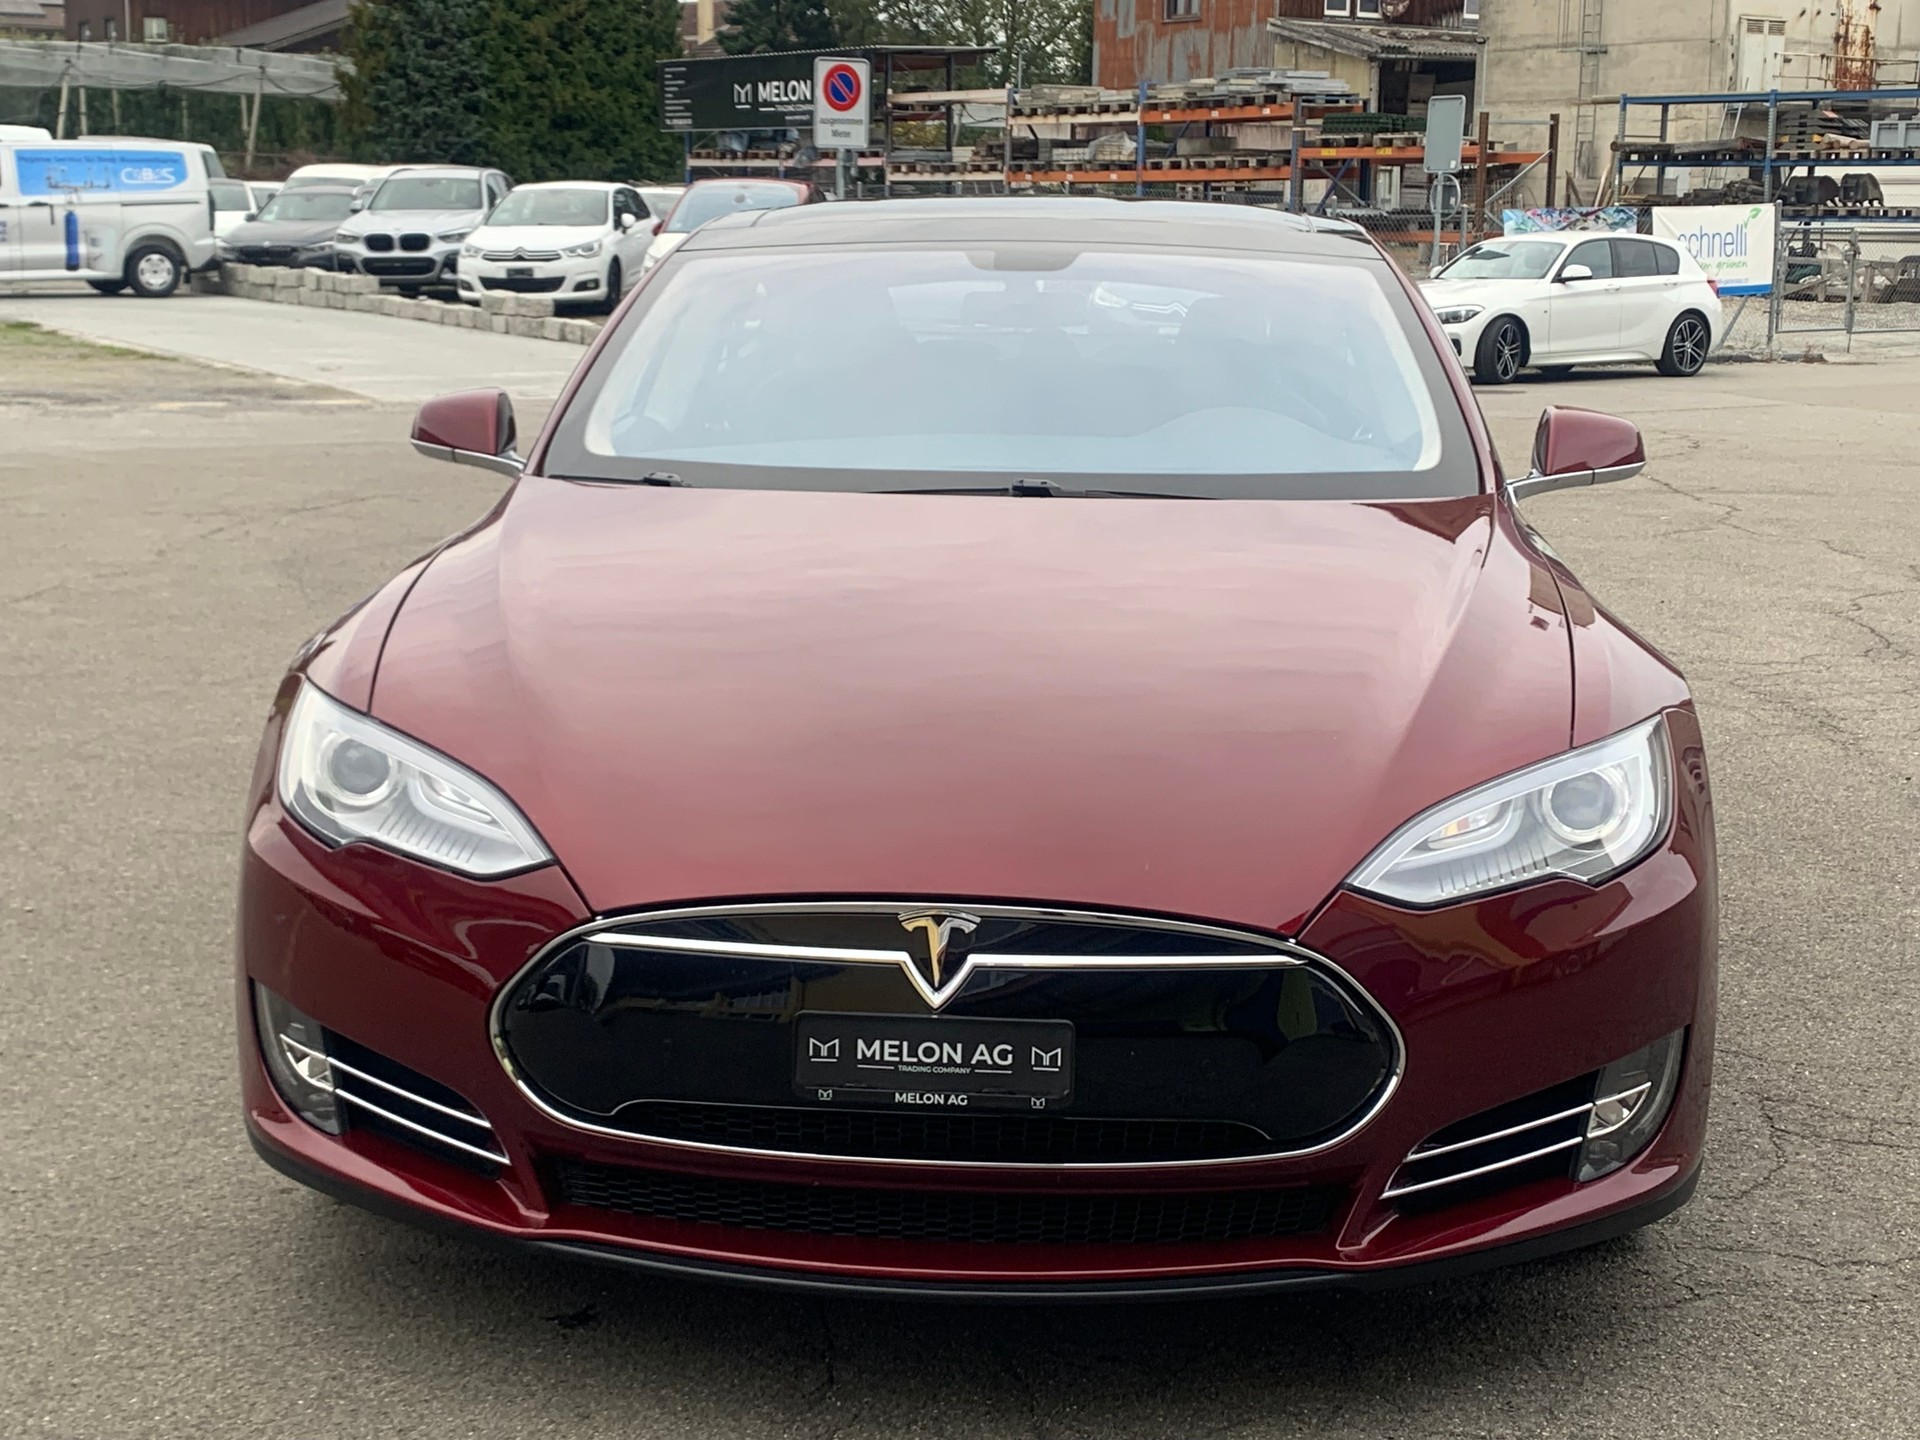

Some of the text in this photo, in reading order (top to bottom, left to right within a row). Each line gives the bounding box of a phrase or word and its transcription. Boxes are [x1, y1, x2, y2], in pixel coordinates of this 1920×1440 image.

[757, 79, 812, 102] MELON
[856, 1038, 963, 1065] MELON
[970, 1043, 1014, 1067] AG
[898, 1064, 972, 1075] TRADING COMPANY
[894, 1091, 945, 1106] MELON
[947, 1093, 968, 1107] AG
